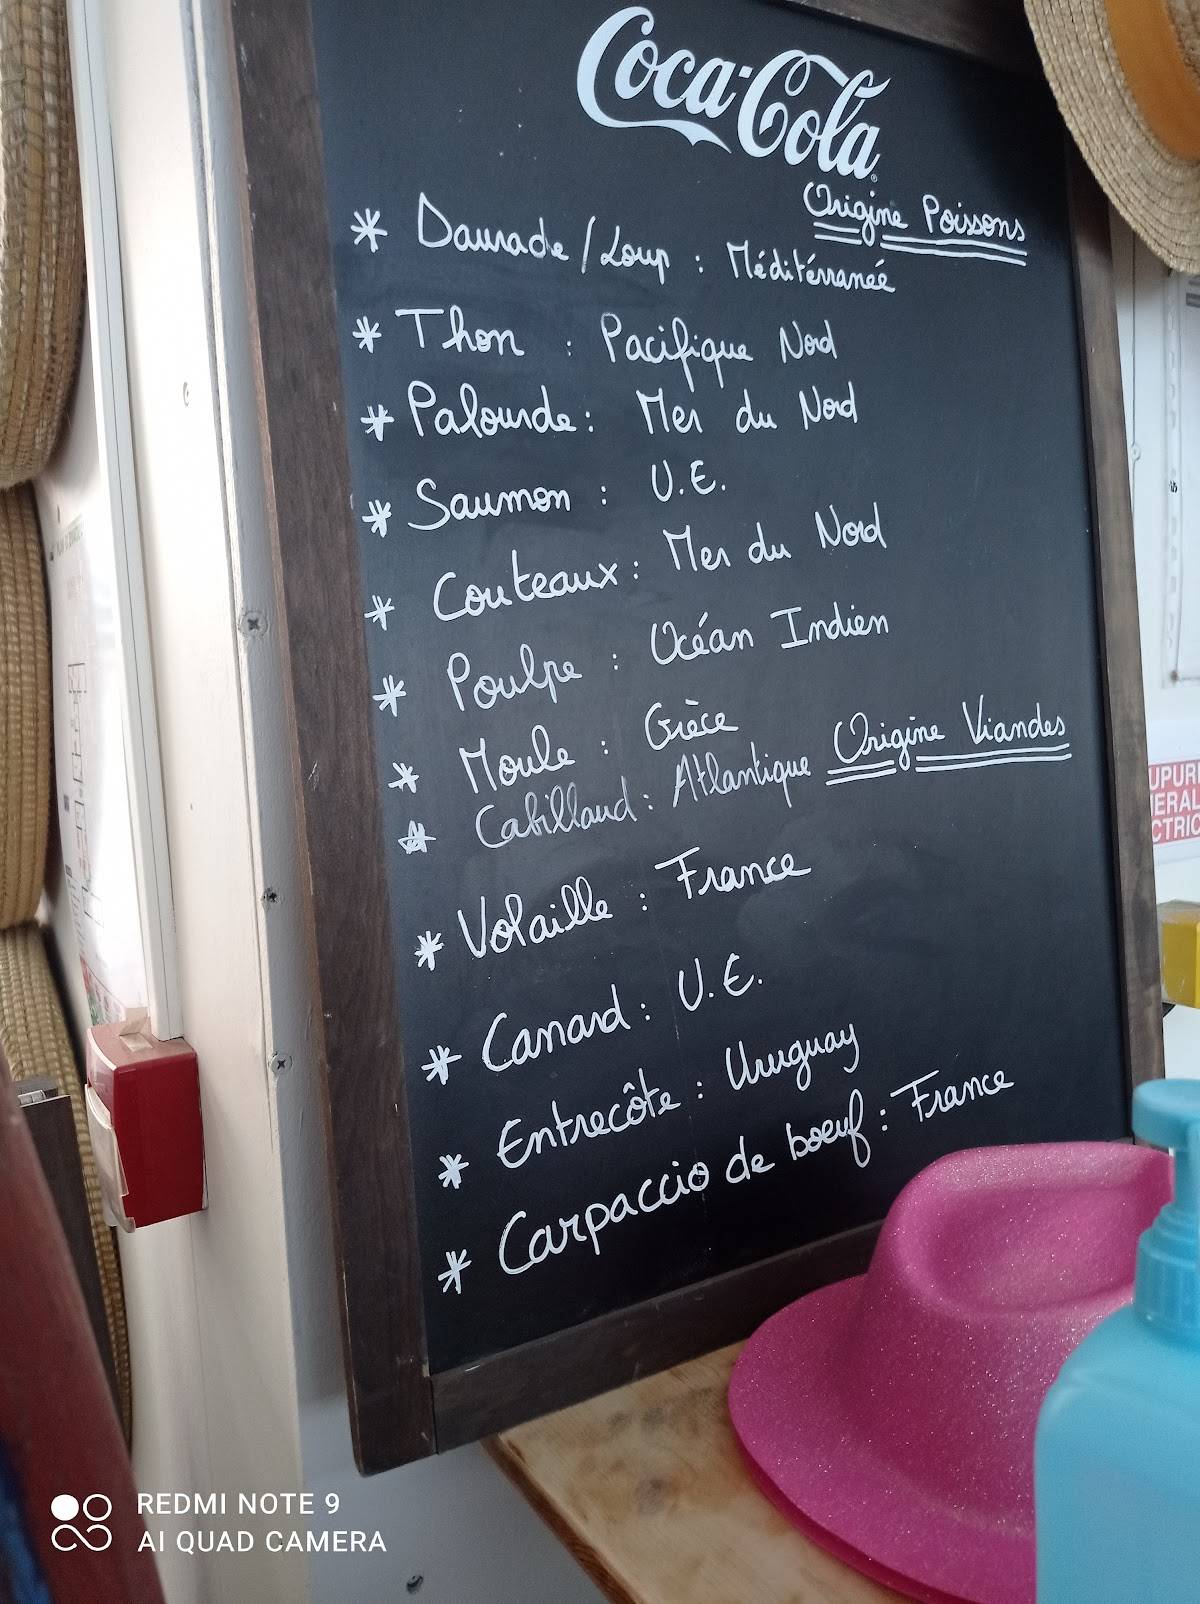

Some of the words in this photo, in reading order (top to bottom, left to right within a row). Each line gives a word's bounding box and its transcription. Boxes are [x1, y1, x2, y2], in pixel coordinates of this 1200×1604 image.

[577, 6, 892, 180] Coca-Cola
[803, 182, 909, 248] Origine
[922, 194, 1026, 242] Poissons
[395, 304, 525, 357] Thon
[600, 312, 754, 393] Pacifique
[779, 320, 838, 364] Nord
[635, 387, 704, 435] Mer
[735, 388, 778, 434] du
[798, 380, 859, 431] Nord
[407, 477, 571, 531] Saumon
[662, 524, 732, 572] Mer
[747, 521, 792, 565] du
[814, 501, 888, 550] Nord
[446, 643, 583, 712] Poulpe
[650, 611, 754, 666] Océan
[769, 600, 889, 650] Indien
[458, 724, 576, 794] Moule
[644, 698, 740, 751] Grèce
[833, 711, 946, 772] Origine
[961, 693, 1066, 745] Viandes
[672, 742, 812, 809] Atlantique
[1148, 762, 1200, 792] UPUR
[1150, 788, 1200, 817] ERAL
[456, 875, 614, 959] Volaille
[655, 846, 812, 900] France
[496, 1067, 682, 1169] Entrecôte
[725, 1023, 860, 1092] Uruguay
[498, 1160, 710, 1275] Carpaccio
[725, 1135, 776, 1184] de
[890, 1069, 1015, 1123] France
